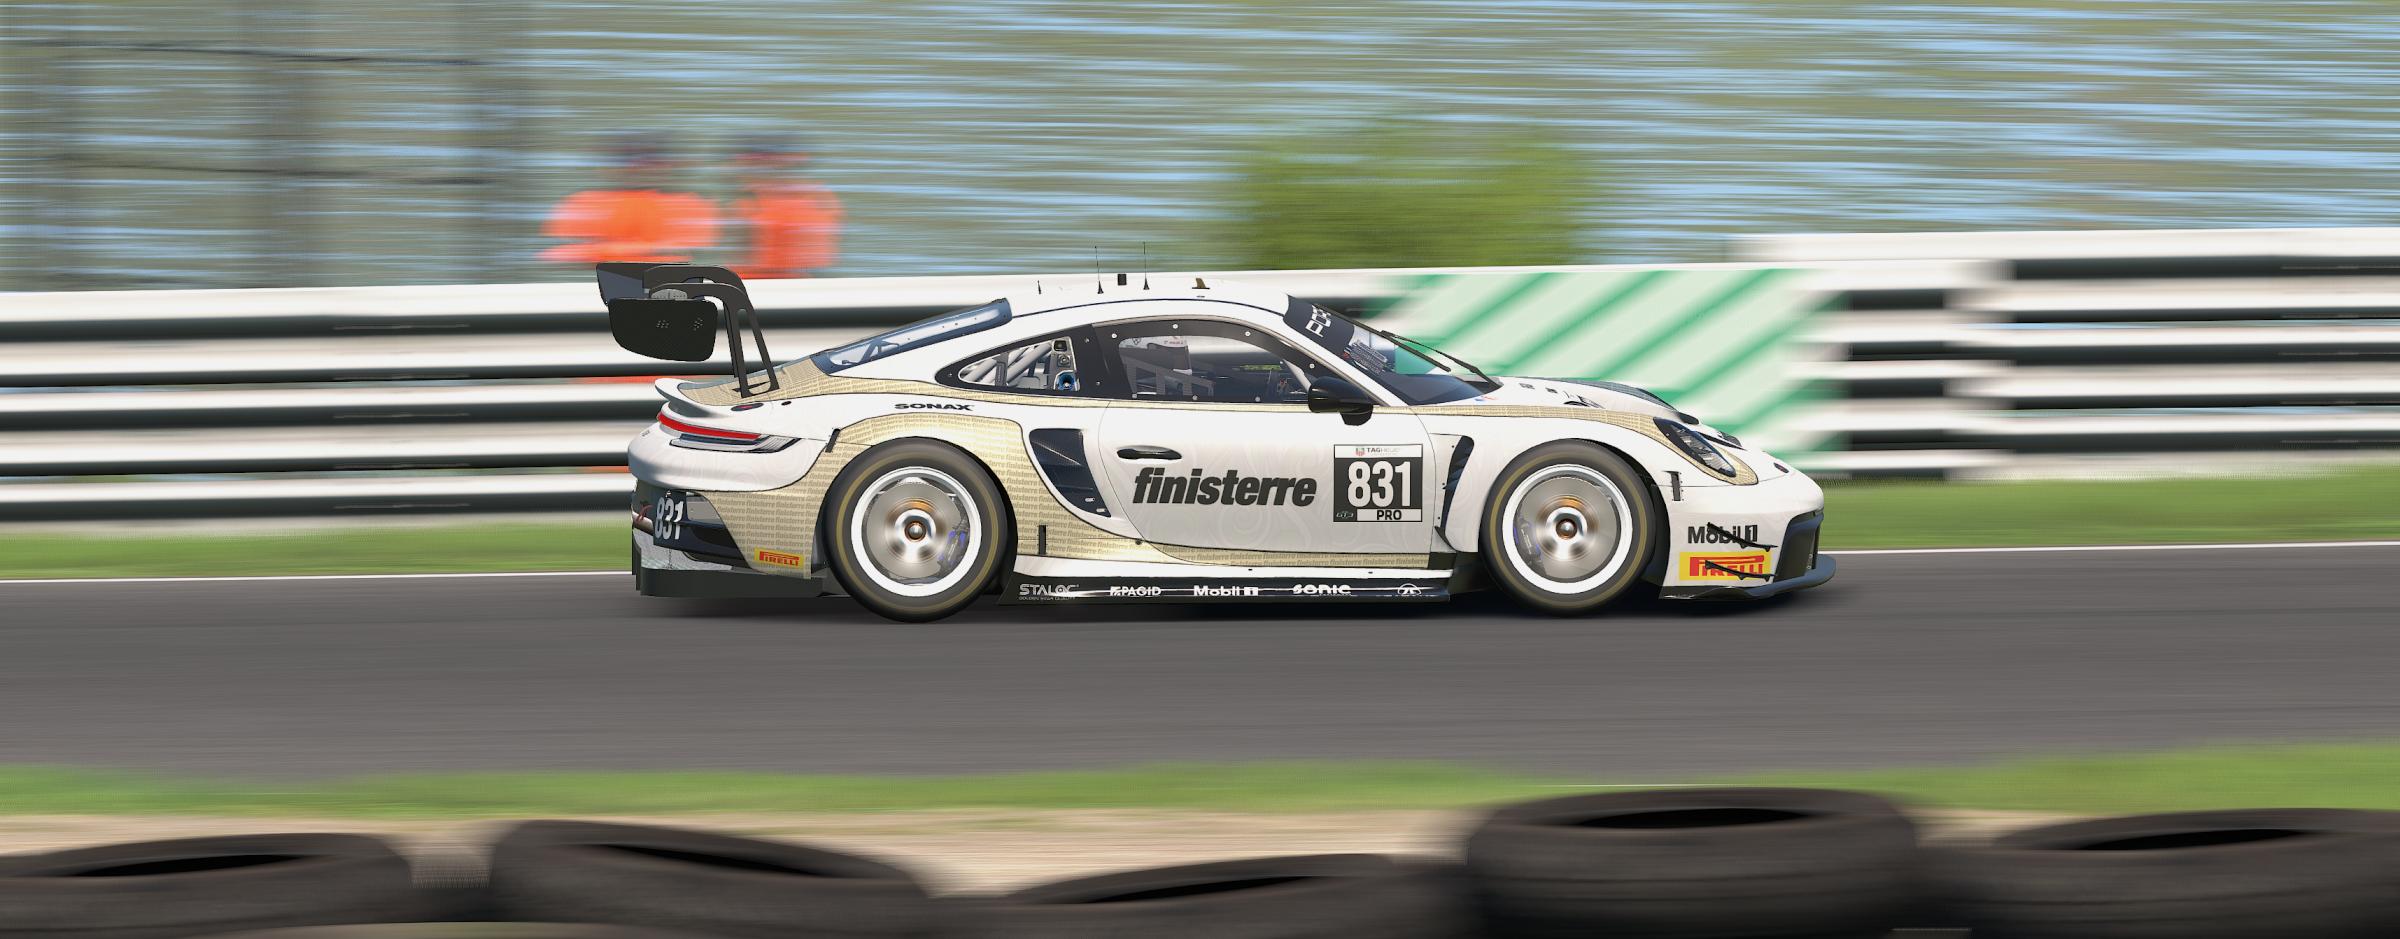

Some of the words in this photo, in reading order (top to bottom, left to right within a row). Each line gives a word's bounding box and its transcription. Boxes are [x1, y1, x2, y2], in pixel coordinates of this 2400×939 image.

[894, 403, 972, 411] SONAX
[1132, 467, 1318, 507] finisterre
[1348, 461, 1410, 507] 831
[655, 497, 684, 540] 831
[1377, 510, 1402, 520] PRO
[760, 551, 799, 566] PIRELLI
[1690, 555, 1764, 576] PIRELLI
[1121, 586, 1161, 597] PAGID
[1193, 585, 1241, 596] Mobil
